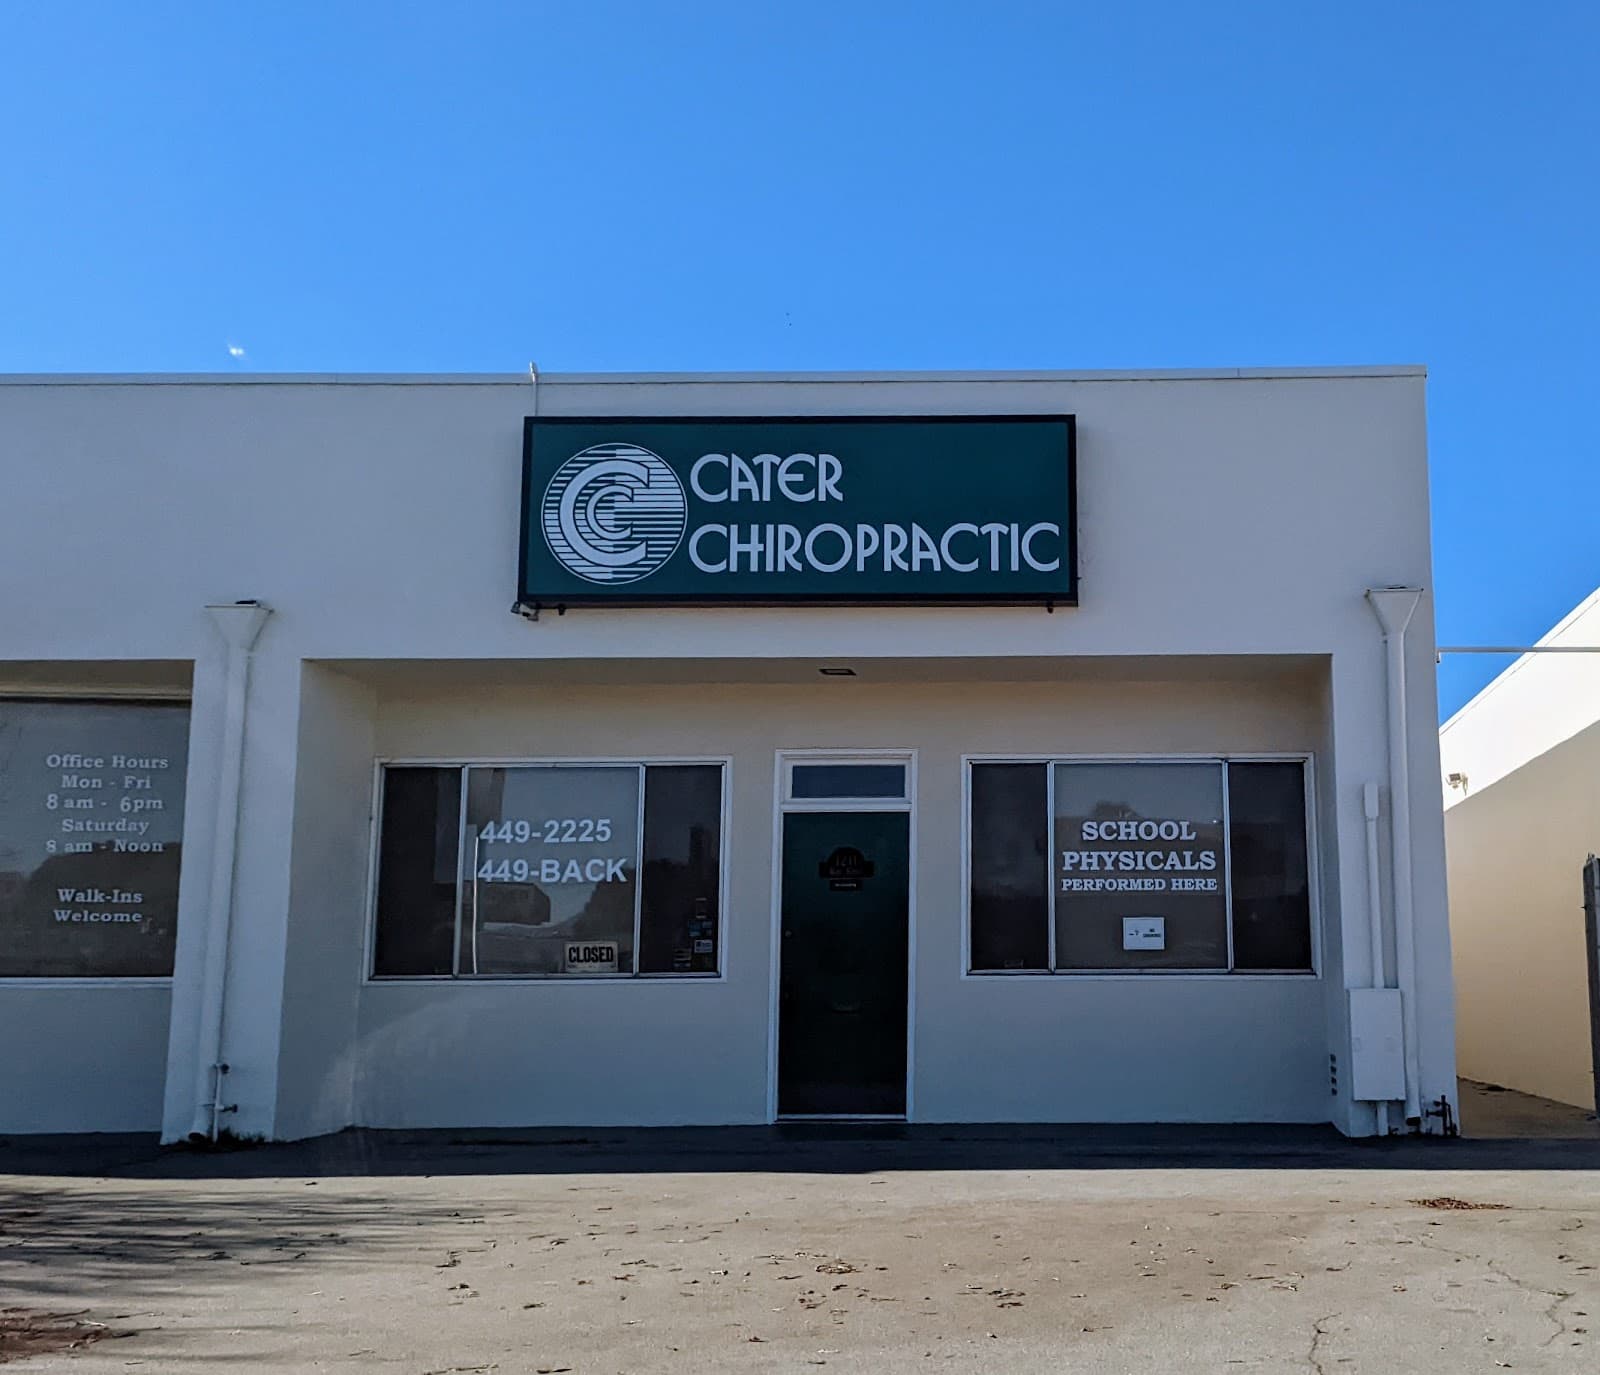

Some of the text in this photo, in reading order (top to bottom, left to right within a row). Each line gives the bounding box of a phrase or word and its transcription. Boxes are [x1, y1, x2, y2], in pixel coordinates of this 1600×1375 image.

[690, 453, 844, 503] CATER
[688, 522, 1060, 574] CHIROPRACTIC
[46, 754, 169, 769] Office Hours
[61, 775, 102, 788] Mon
[124, 776, 152, 789] Fri
[120, 796, 163, 812] 6pm
[62, 819, 149, 835] Saturday
[479, 819, 612, 844] 449-2225
[1082, 821, 1197, 841] SCHOOL
[114, 840, 164, 853] Noon
[1062, 851, 1217, 871] PHYSICALS
[477, 857, 628, 883] 449-BACK
[1061, 878, 1218, 891] PERFORMED HERE
[57, 888, 143, 903] Walk-Ins
[54, 910, 143, 922] Welcome
[568, 946, 614, 963] CLOSED
